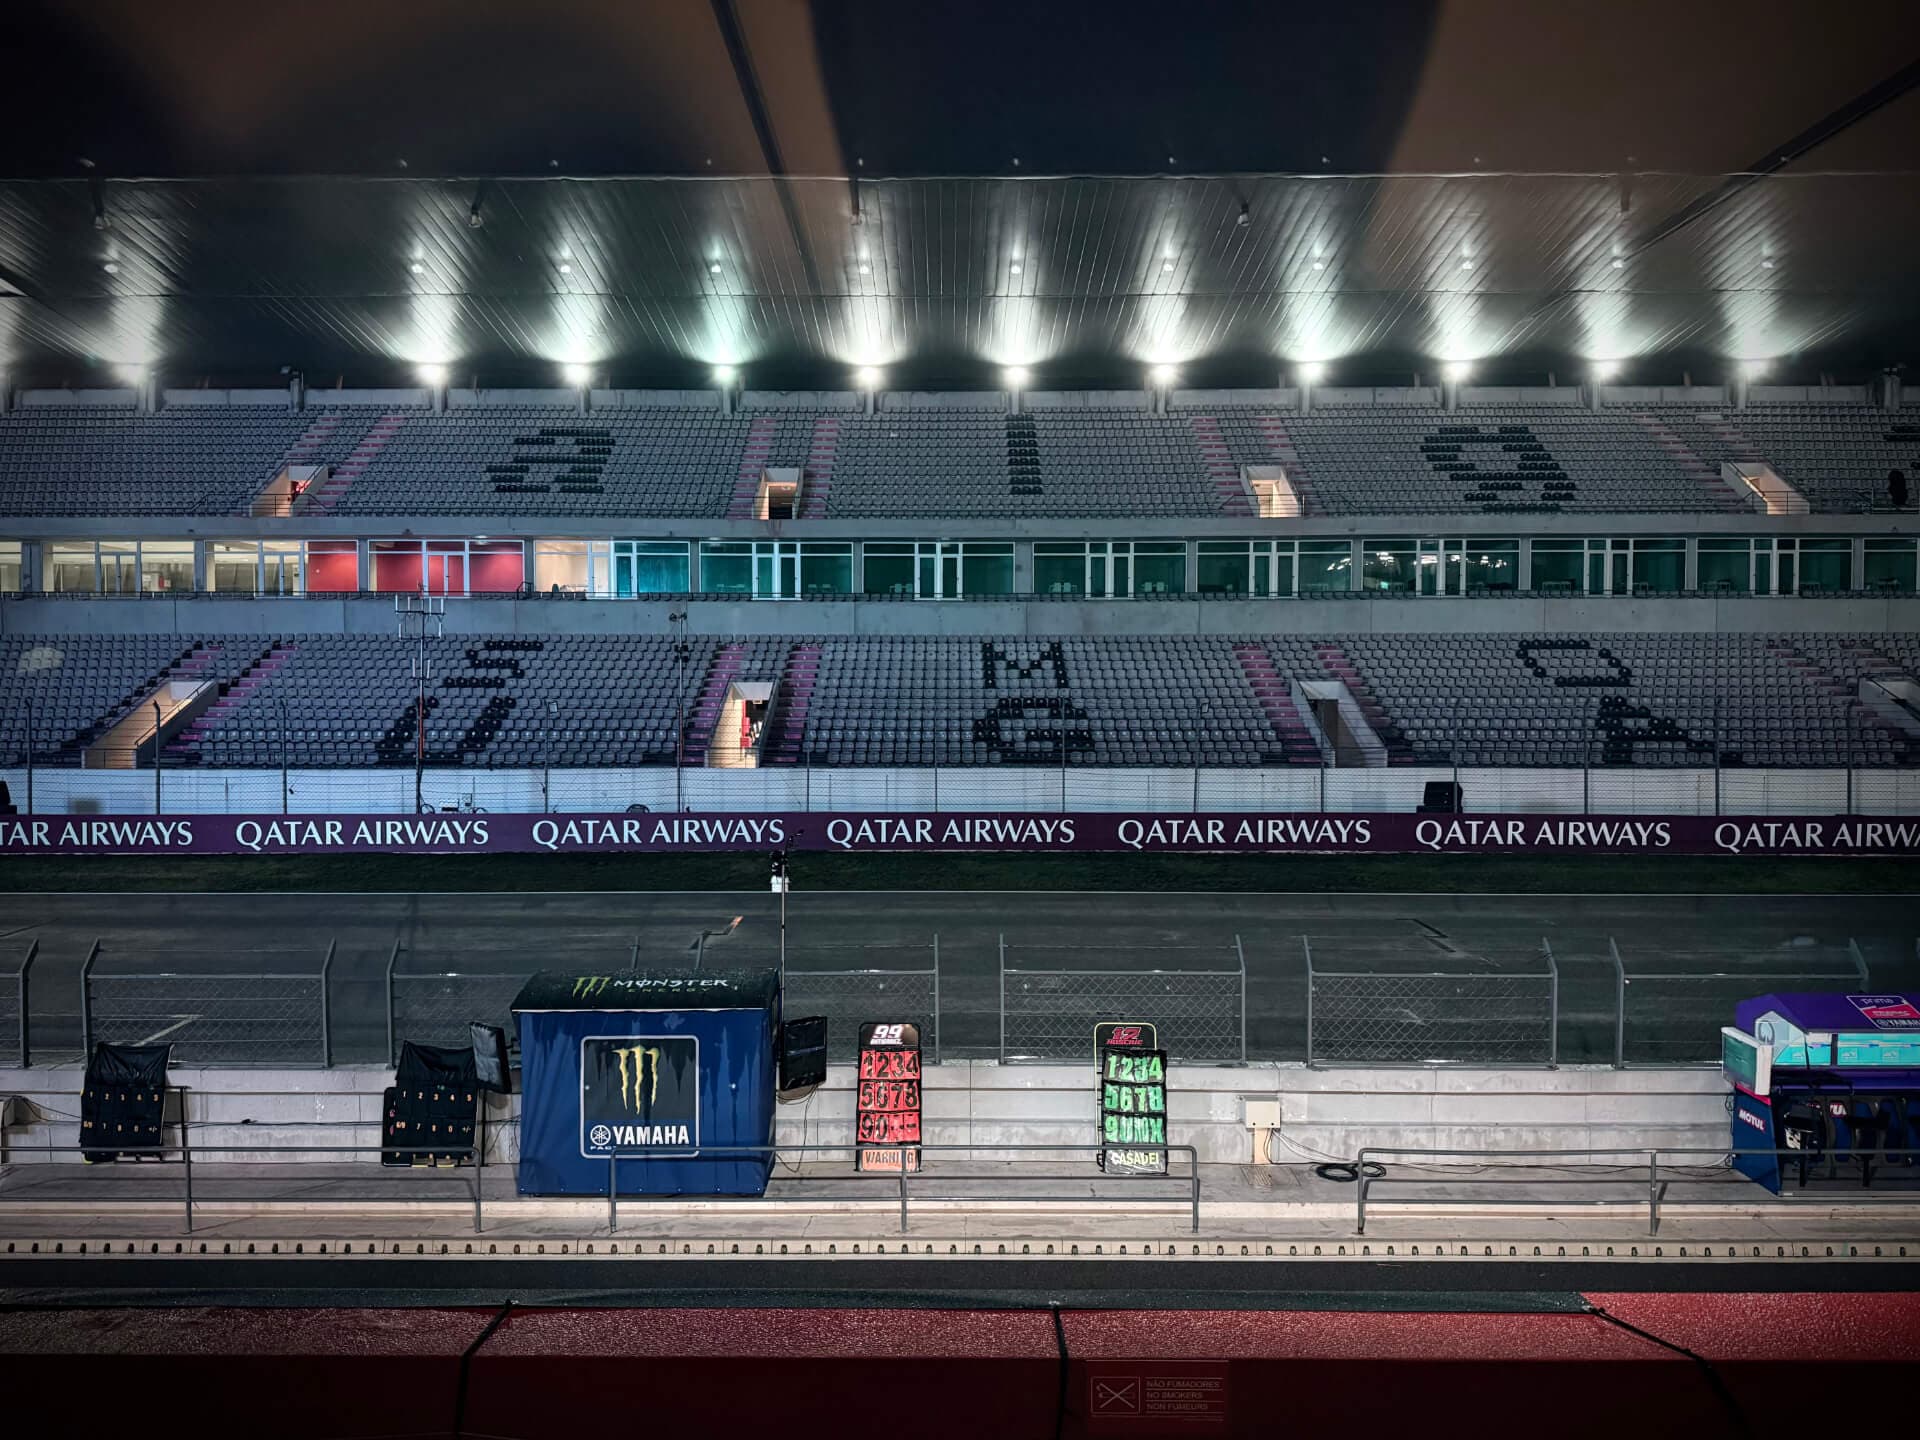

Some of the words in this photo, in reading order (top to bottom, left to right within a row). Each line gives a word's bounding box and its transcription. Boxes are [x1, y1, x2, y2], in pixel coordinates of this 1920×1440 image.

[58, 821, 193, 847] AIRWAYS
[235, 821, 345, 850] QATAR
[352, 821, 489, 846] AIRWAYS
[532, 820, 641, 850] QATAR
[652, 819, 785, 845] AIRWAYS
[827, 818, 936, 848] QATAR
[941, 819, 1075, 844] AIRWAYS
[1117, 819, 1226, 850] QATAR
[1233, 819, 1371, 844] AIRWAYS
[1415, 820, 1526, 851] QATAR
[1534, 822, 1671, 847] AIRWAYS
[1714, 822, 1824, 854] QATAR
[1832, 822, 1920, 847] AIRW
[613, 979, 729, 988] MONSTER
[1738, 1108, 1765, 1131] MOTUL
[612, 1125, 690, 1145] YAMAHA
[865, 1150, 914, 1165] WARNIG
